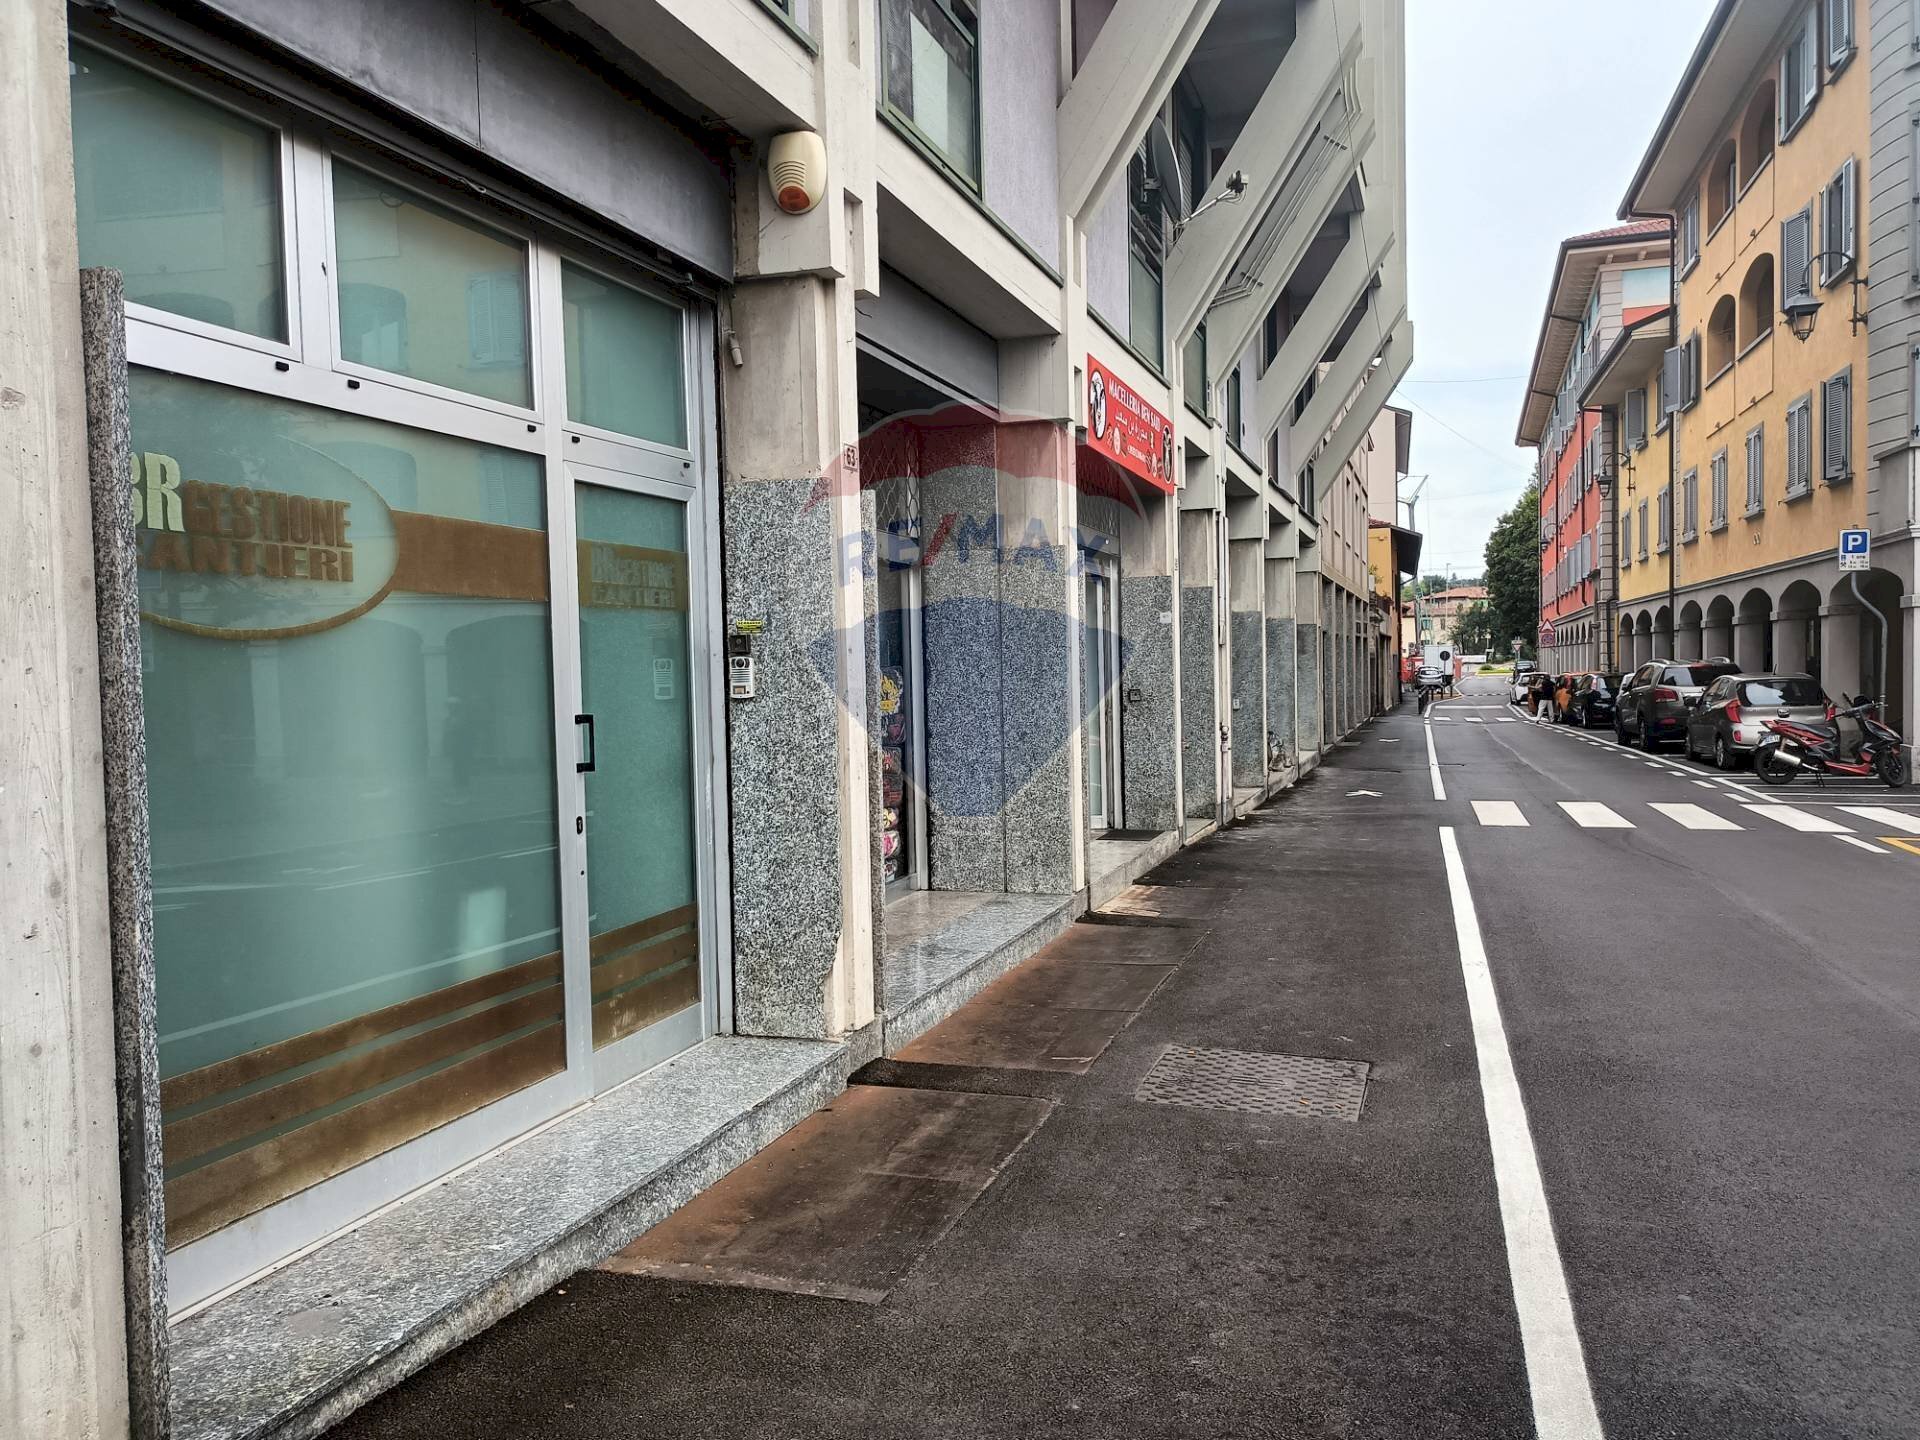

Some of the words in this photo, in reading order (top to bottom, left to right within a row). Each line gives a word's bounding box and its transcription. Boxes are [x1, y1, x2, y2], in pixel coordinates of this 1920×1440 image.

[1109, 378, 1141, 416] MACELLERIA
[1141, 403, 1151, 425] BEN
[1151, 410, 1161, 433] SAID
[846, 447, 856, 467] 63
[184, 480, 353, 548] GESTIONE
[1847, 534, 1863, 551] P
